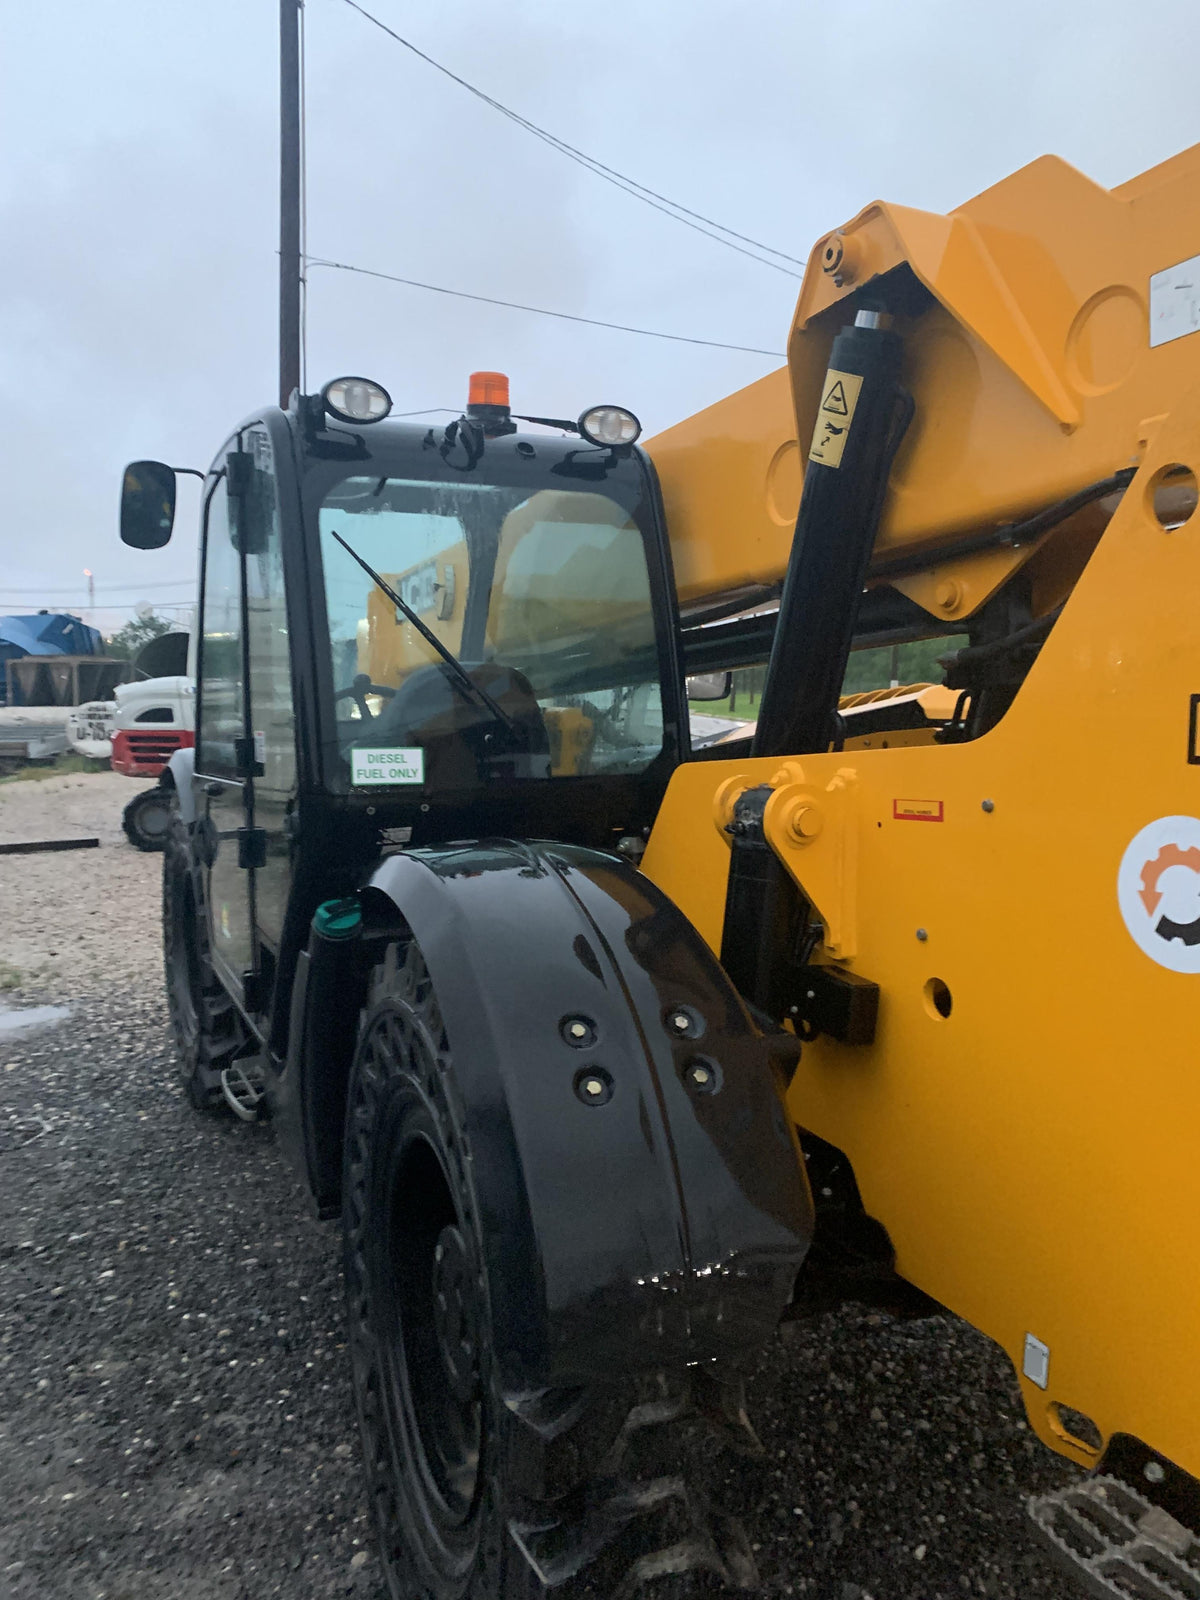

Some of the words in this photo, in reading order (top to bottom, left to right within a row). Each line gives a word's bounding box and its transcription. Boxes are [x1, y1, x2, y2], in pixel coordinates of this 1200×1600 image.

[367, 753, 408, 764] DIESEL
[356, 769, 386, 779] FUEL
[388, 768, 419, 779] ONLY
